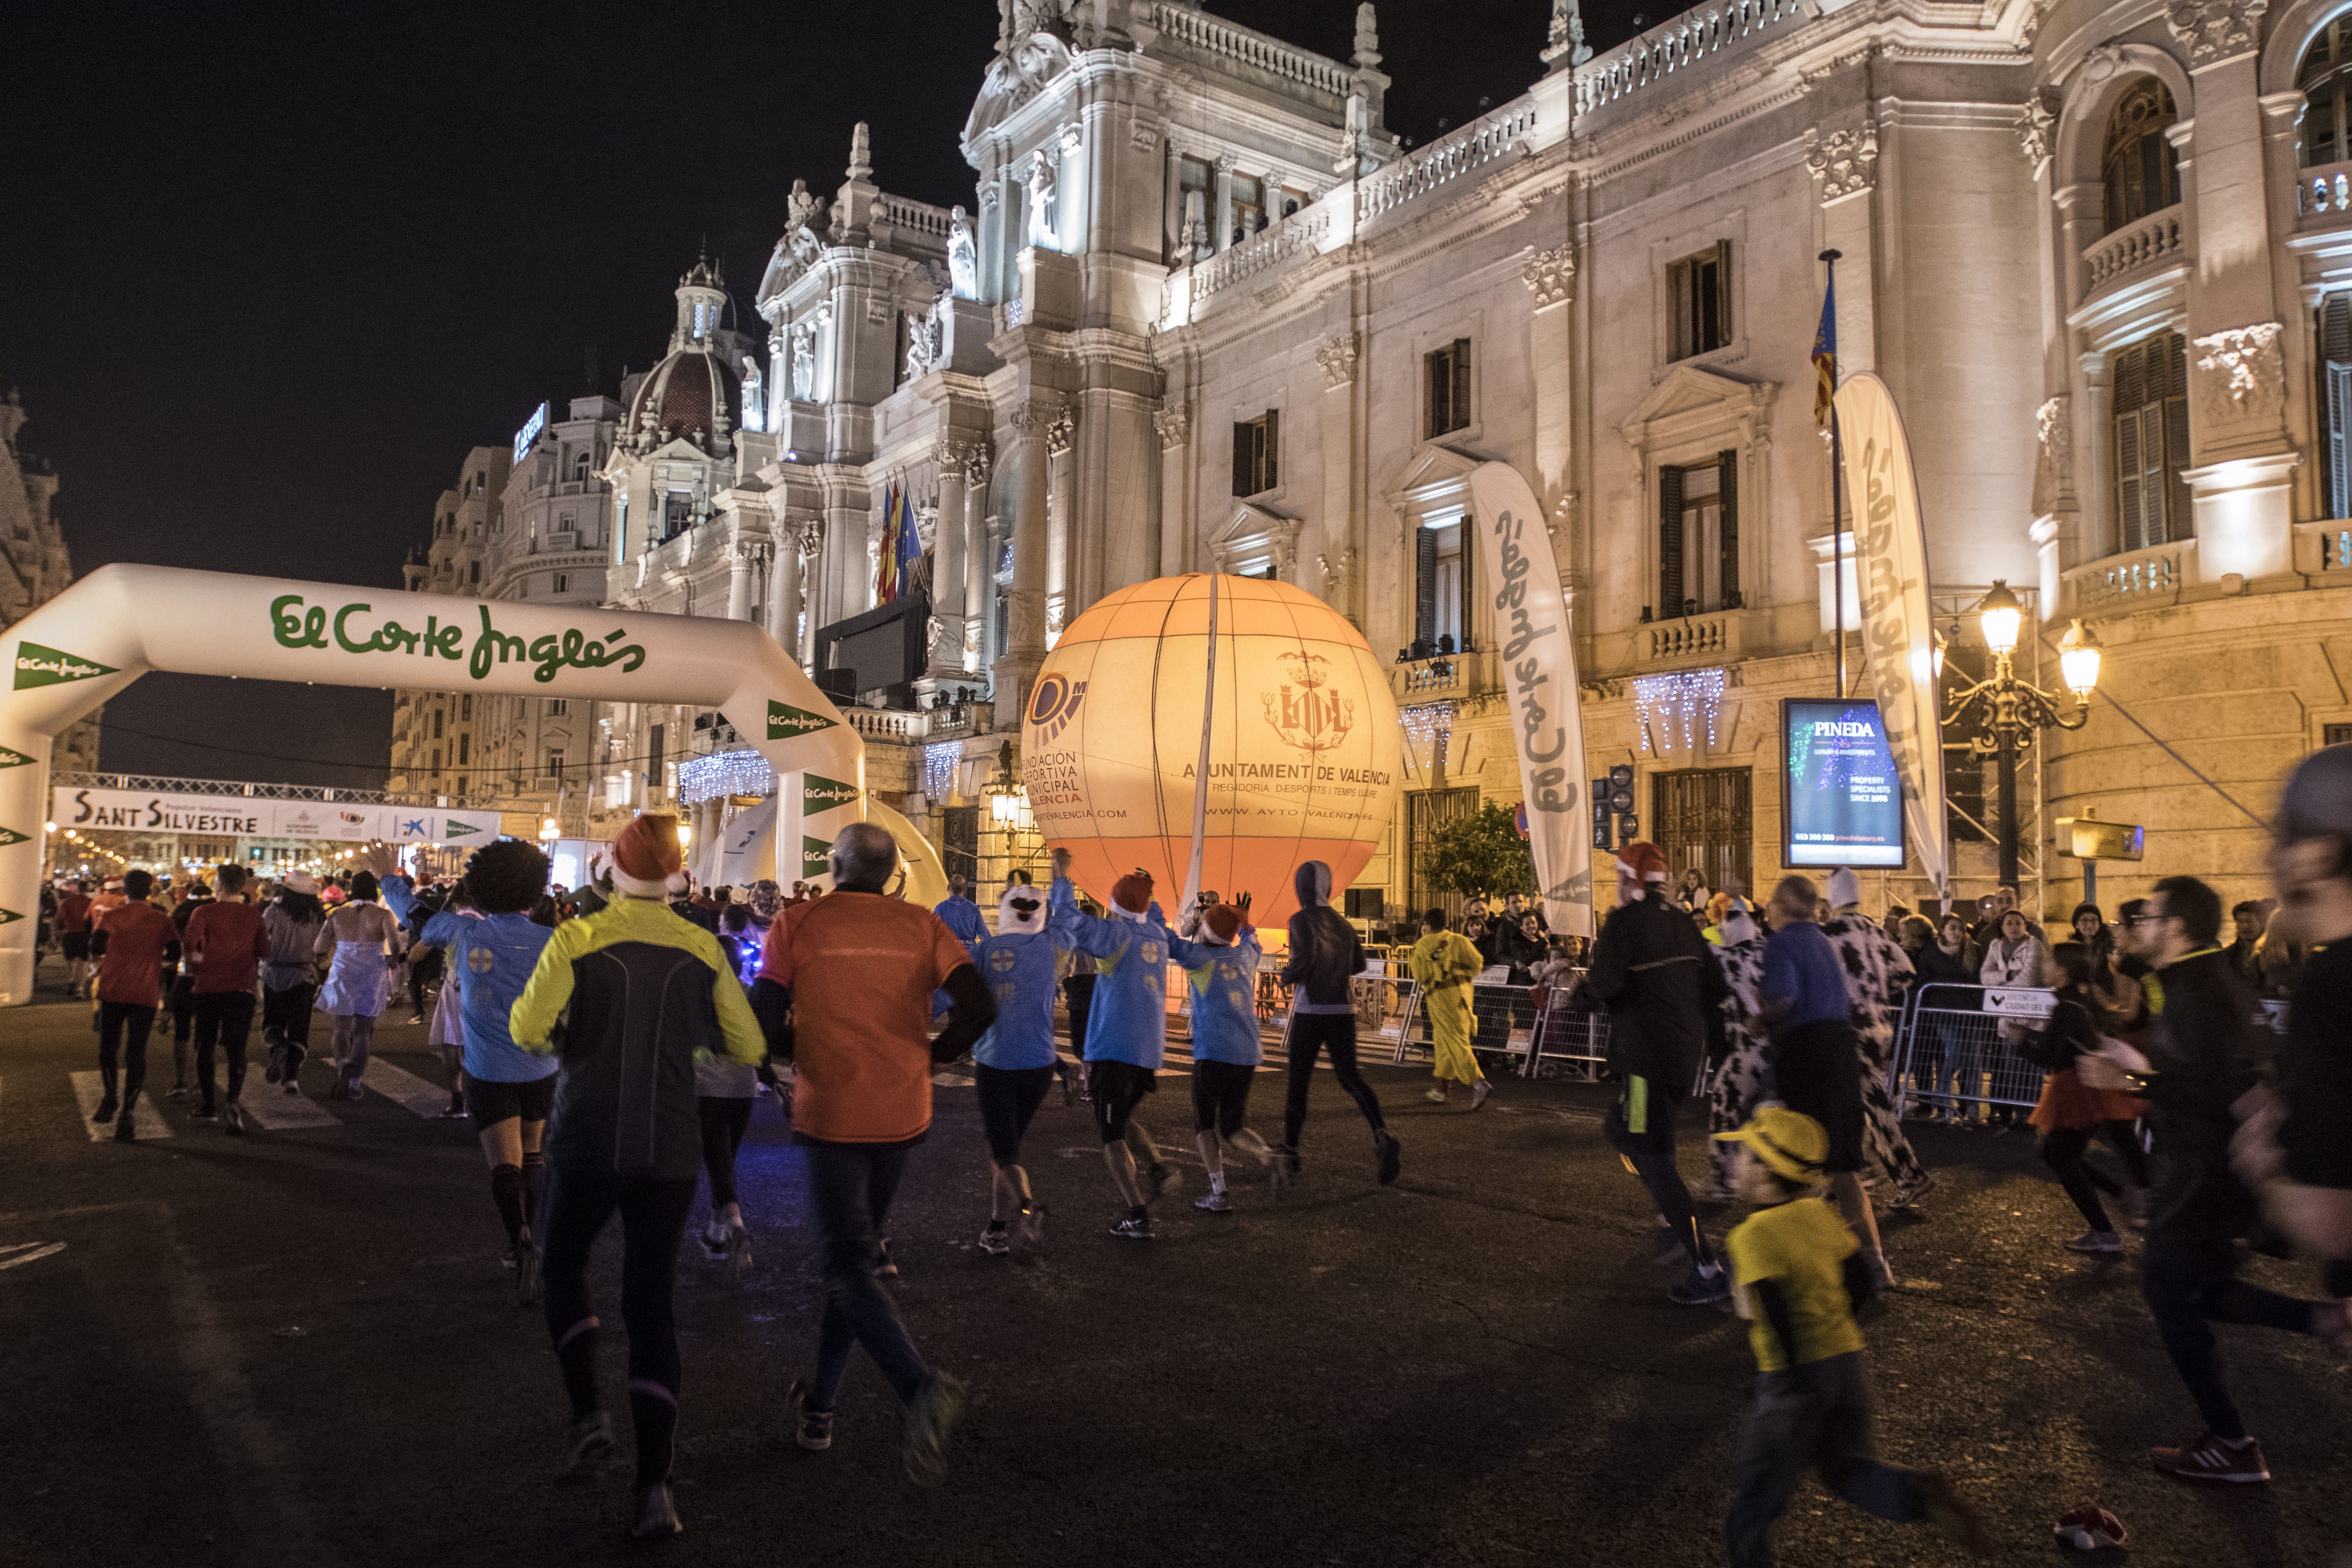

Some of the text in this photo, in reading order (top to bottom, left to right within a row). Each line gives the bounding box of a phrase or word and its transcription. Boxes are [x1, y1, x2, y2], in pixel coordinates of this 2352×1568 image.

[270, 594, 646, 683] El Corte Inglés
[768, 714, 827, 729] El Corte Inglés
[1814, 721, 1875, 737] PINEDA
[1023, 750, 1075, 770] FUNDACIÓN
[1024, 765, 1077, 784] DEPORTIVA
[1183, 763, 1390, 787] AUNTAMENT DE VALENCIA
[804, 789, 813, 798] El
[814, 788, 833, 798] Corte
[1213, 784, 1269, 792] REGIDORIA
[1334, 787, 1356, 797] TEMPS
[1850, 785, 1891, 793] SPECIALISTS
[1850, 794, 1870, 802] SINCE
[75, 790, 258, 833] SANT SILVESTRE
[804, 851, 812, 861] El
